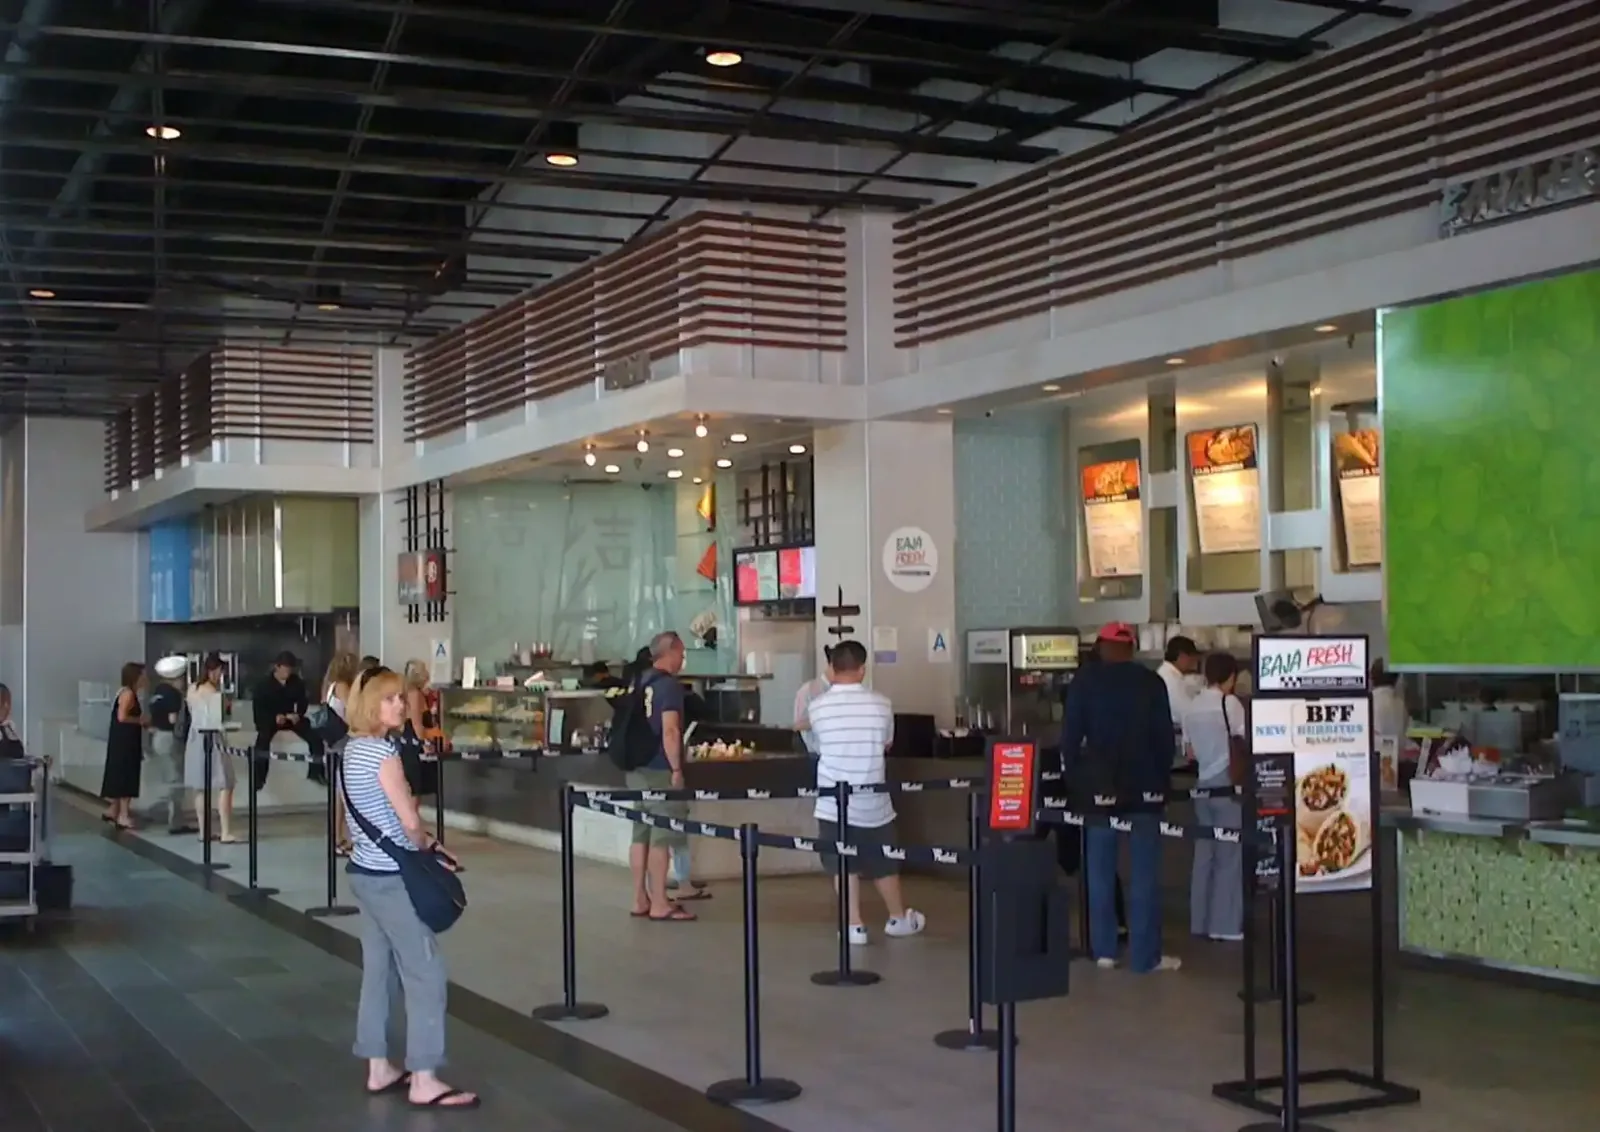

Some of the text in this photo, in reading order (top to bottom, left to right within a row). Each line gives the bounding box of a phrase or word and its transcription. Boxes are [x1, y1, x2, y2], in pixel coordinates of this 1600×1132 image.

[435, 643, 446, 656] A
[933, 633, 946, 651] A
[1260, 643, 1353, 677] BAJA FRESH
[1306, 704, 1354, 722] BFF
[1256, 725, 1287, 736] NEW
